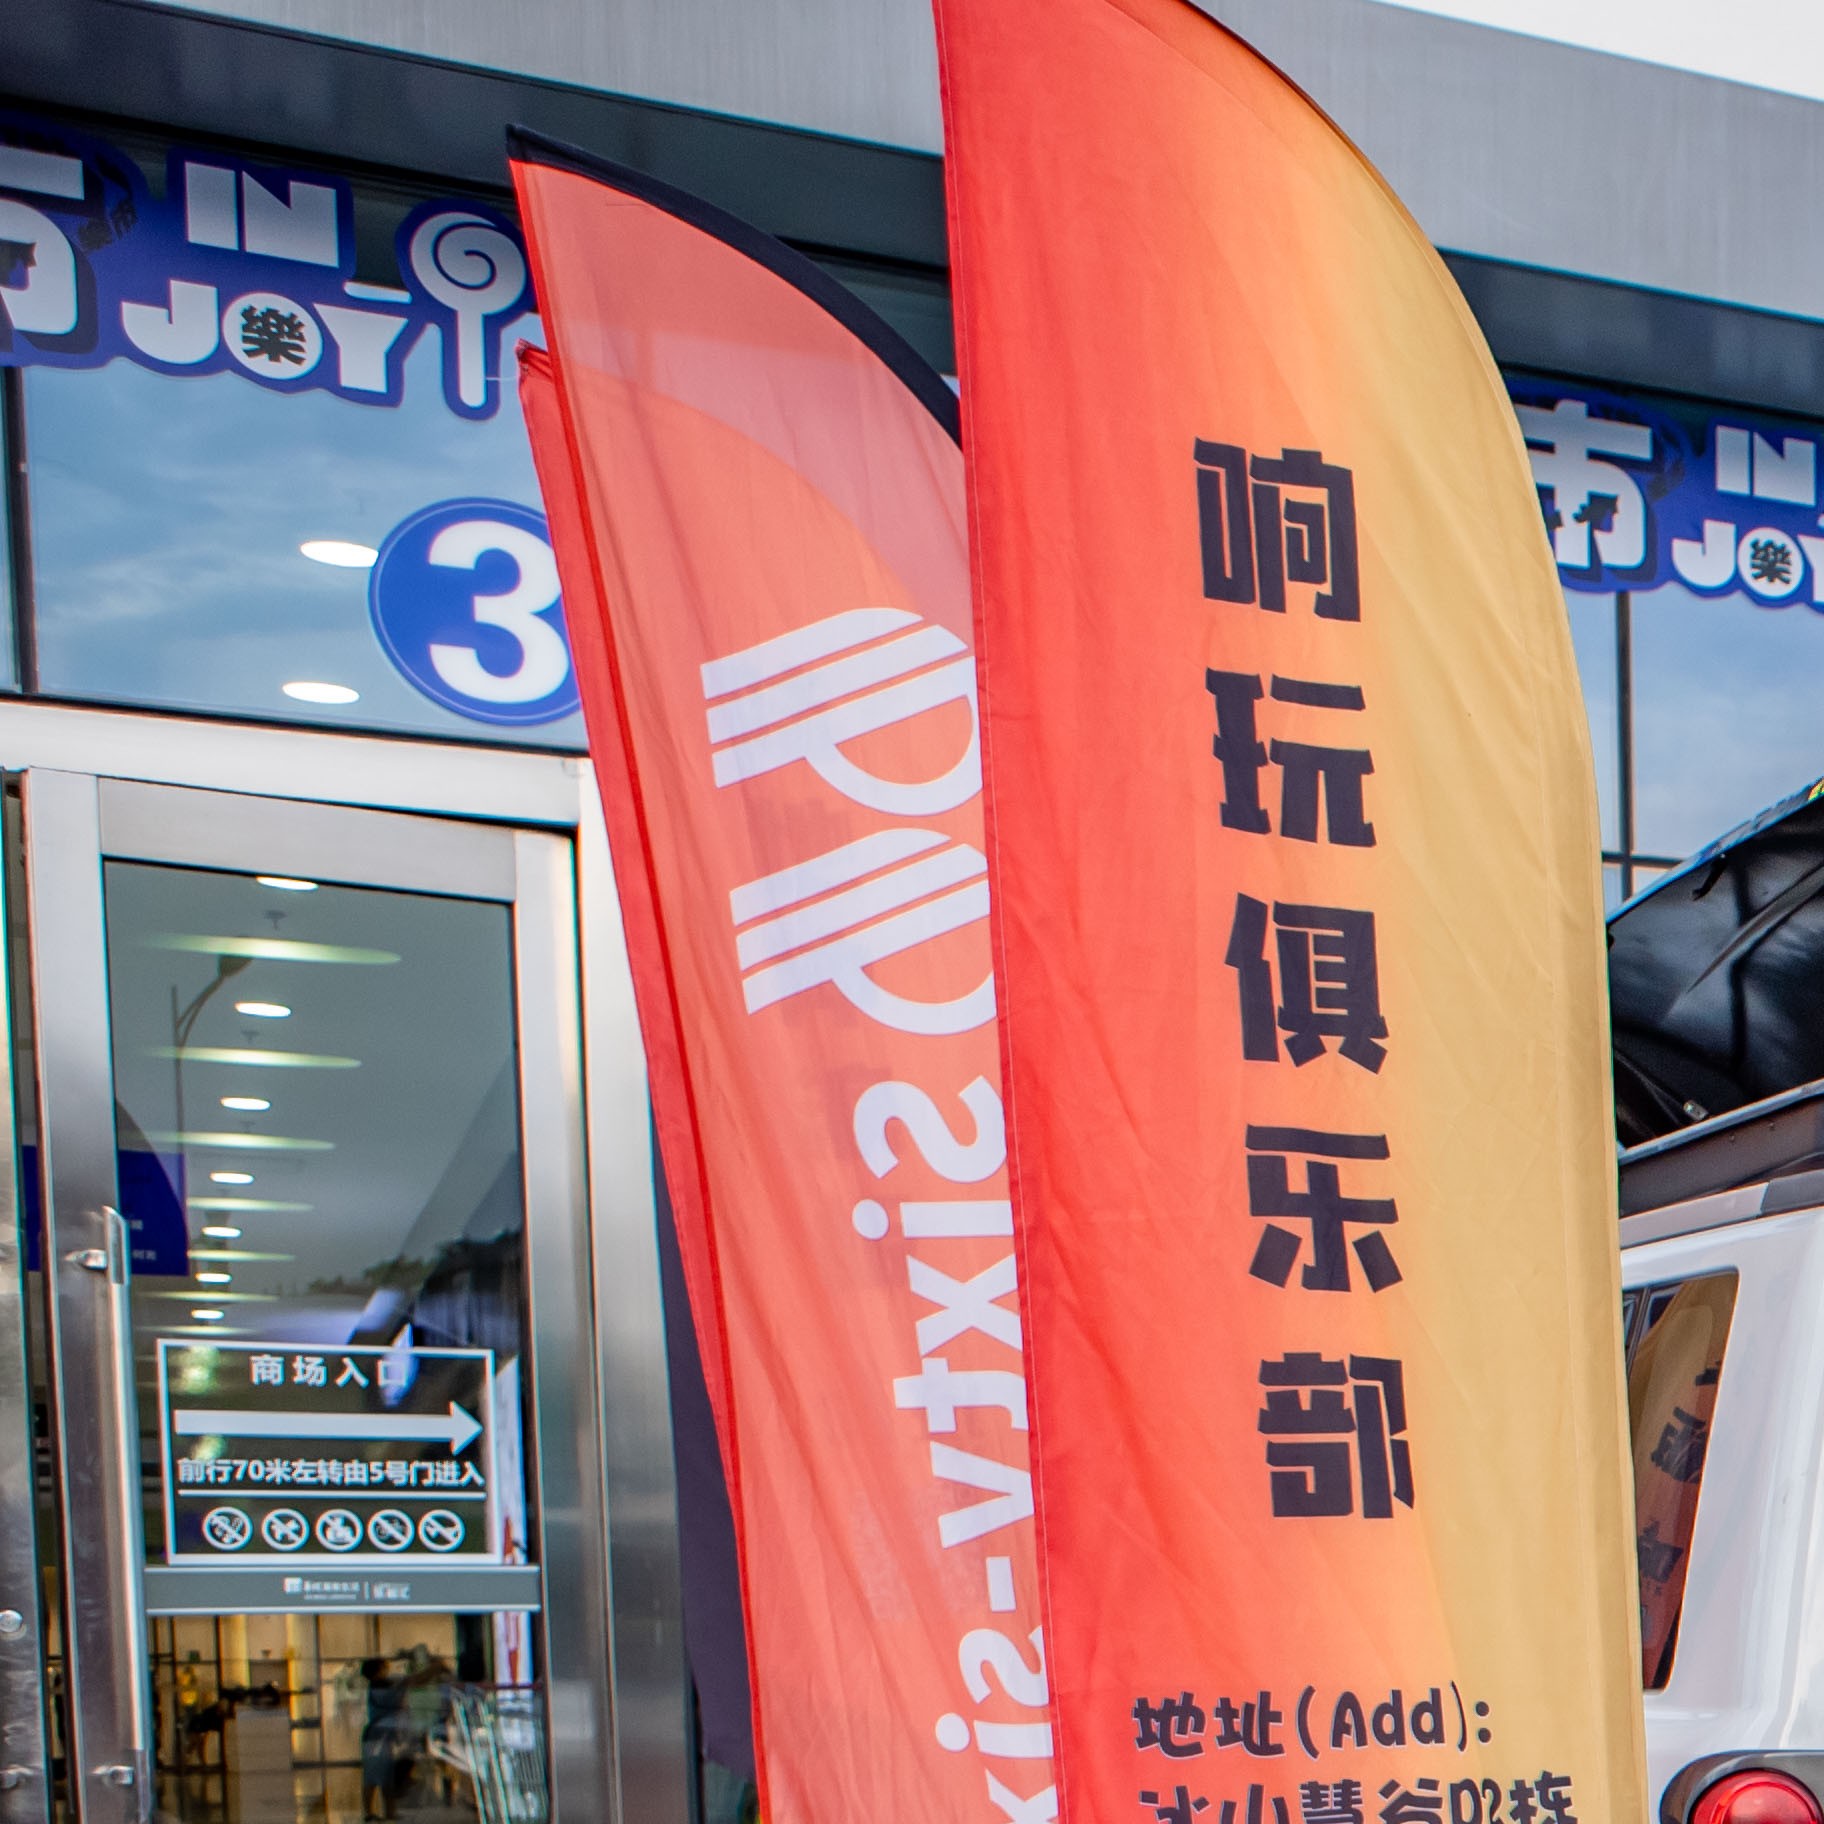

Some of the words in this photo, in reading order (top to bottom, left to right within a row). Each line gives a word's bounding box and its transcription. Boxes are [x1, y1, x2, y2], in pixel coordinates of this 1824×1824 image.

[184, 160, 341, 268] IN
[1715, 424, 1816, 507] IN
[427, 519, 571, 705] 3
[1193, 435, 1416, 1520] 响玩俱乐部
[249, 1353, 410, 1389] 商场入口
[177, 1458, 486, 1488] 前行70米左转由5号门进入
[1131, 1680, 1493, 1759] 地址(Add):
